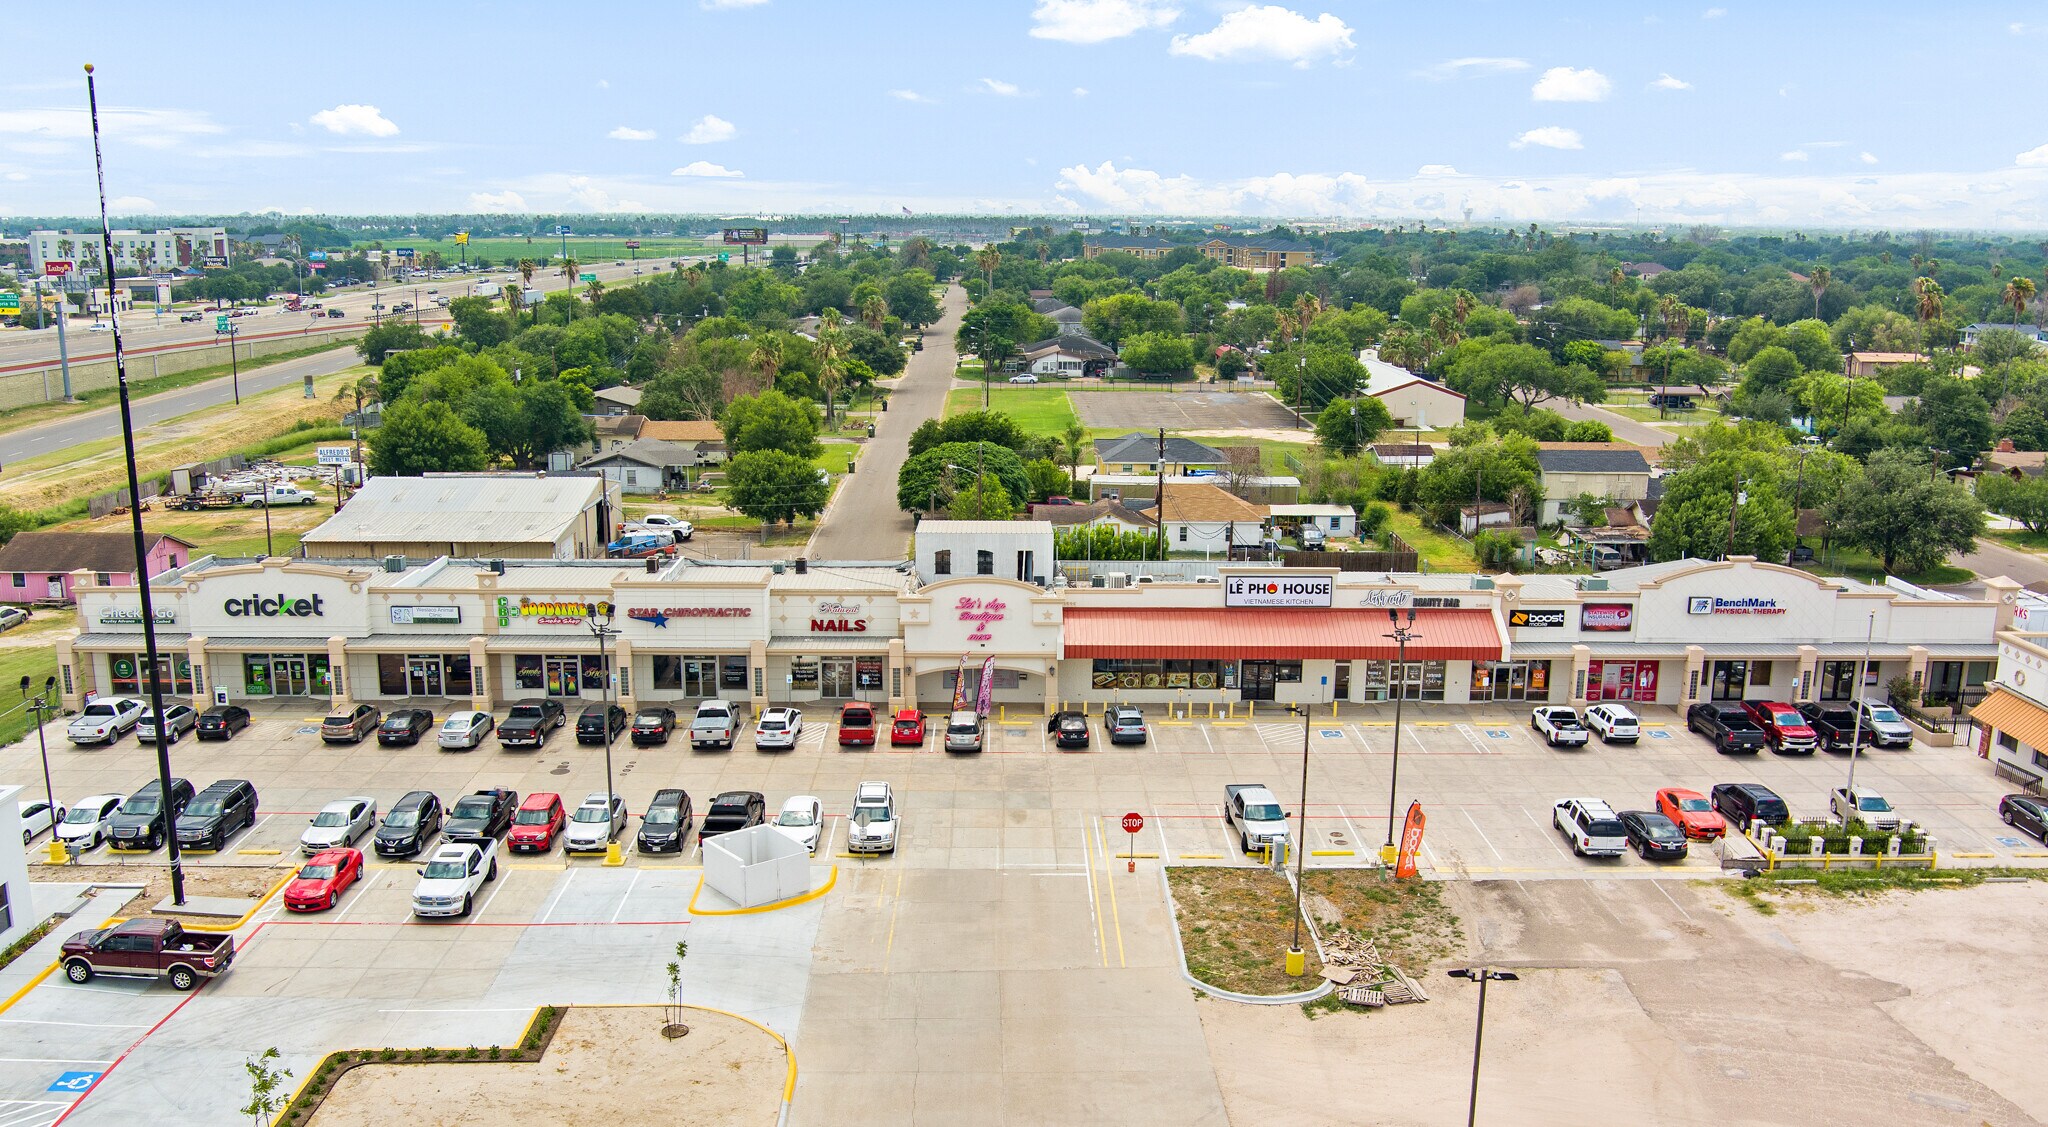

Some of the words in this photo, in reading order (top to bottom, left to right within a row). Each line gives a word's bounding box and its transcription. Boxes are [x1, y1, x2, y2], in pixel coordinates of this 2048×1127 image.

[1283, 583, 1330, 594] HOUSE
[224, 593, 324, 617] cricket
[1412, 597, 1442, 607] BEAUTY
[1443, 597, 1460, 607] BAR
[1715, 598, 1777, 607] BenchMark
[100, 606, 141, 618] Check
[627, 608, 658, 618] STAR
[661, 608, 751, 618] CHIROPRACTIC
[819, 602, 860, 614] Natural
[562, 617, 581, 625] Shop
[959, 611, 1004, 624] Boutique
[1528, 613, 1563, 623] boost
[810, 619, 867, 632] NAILS
[966, 633, 992, 641] more
[1122, 818, 1143, 827] STOP
[1404, 828, 1412, 852] mobile
[1404, 827, 1422, 870] boost
